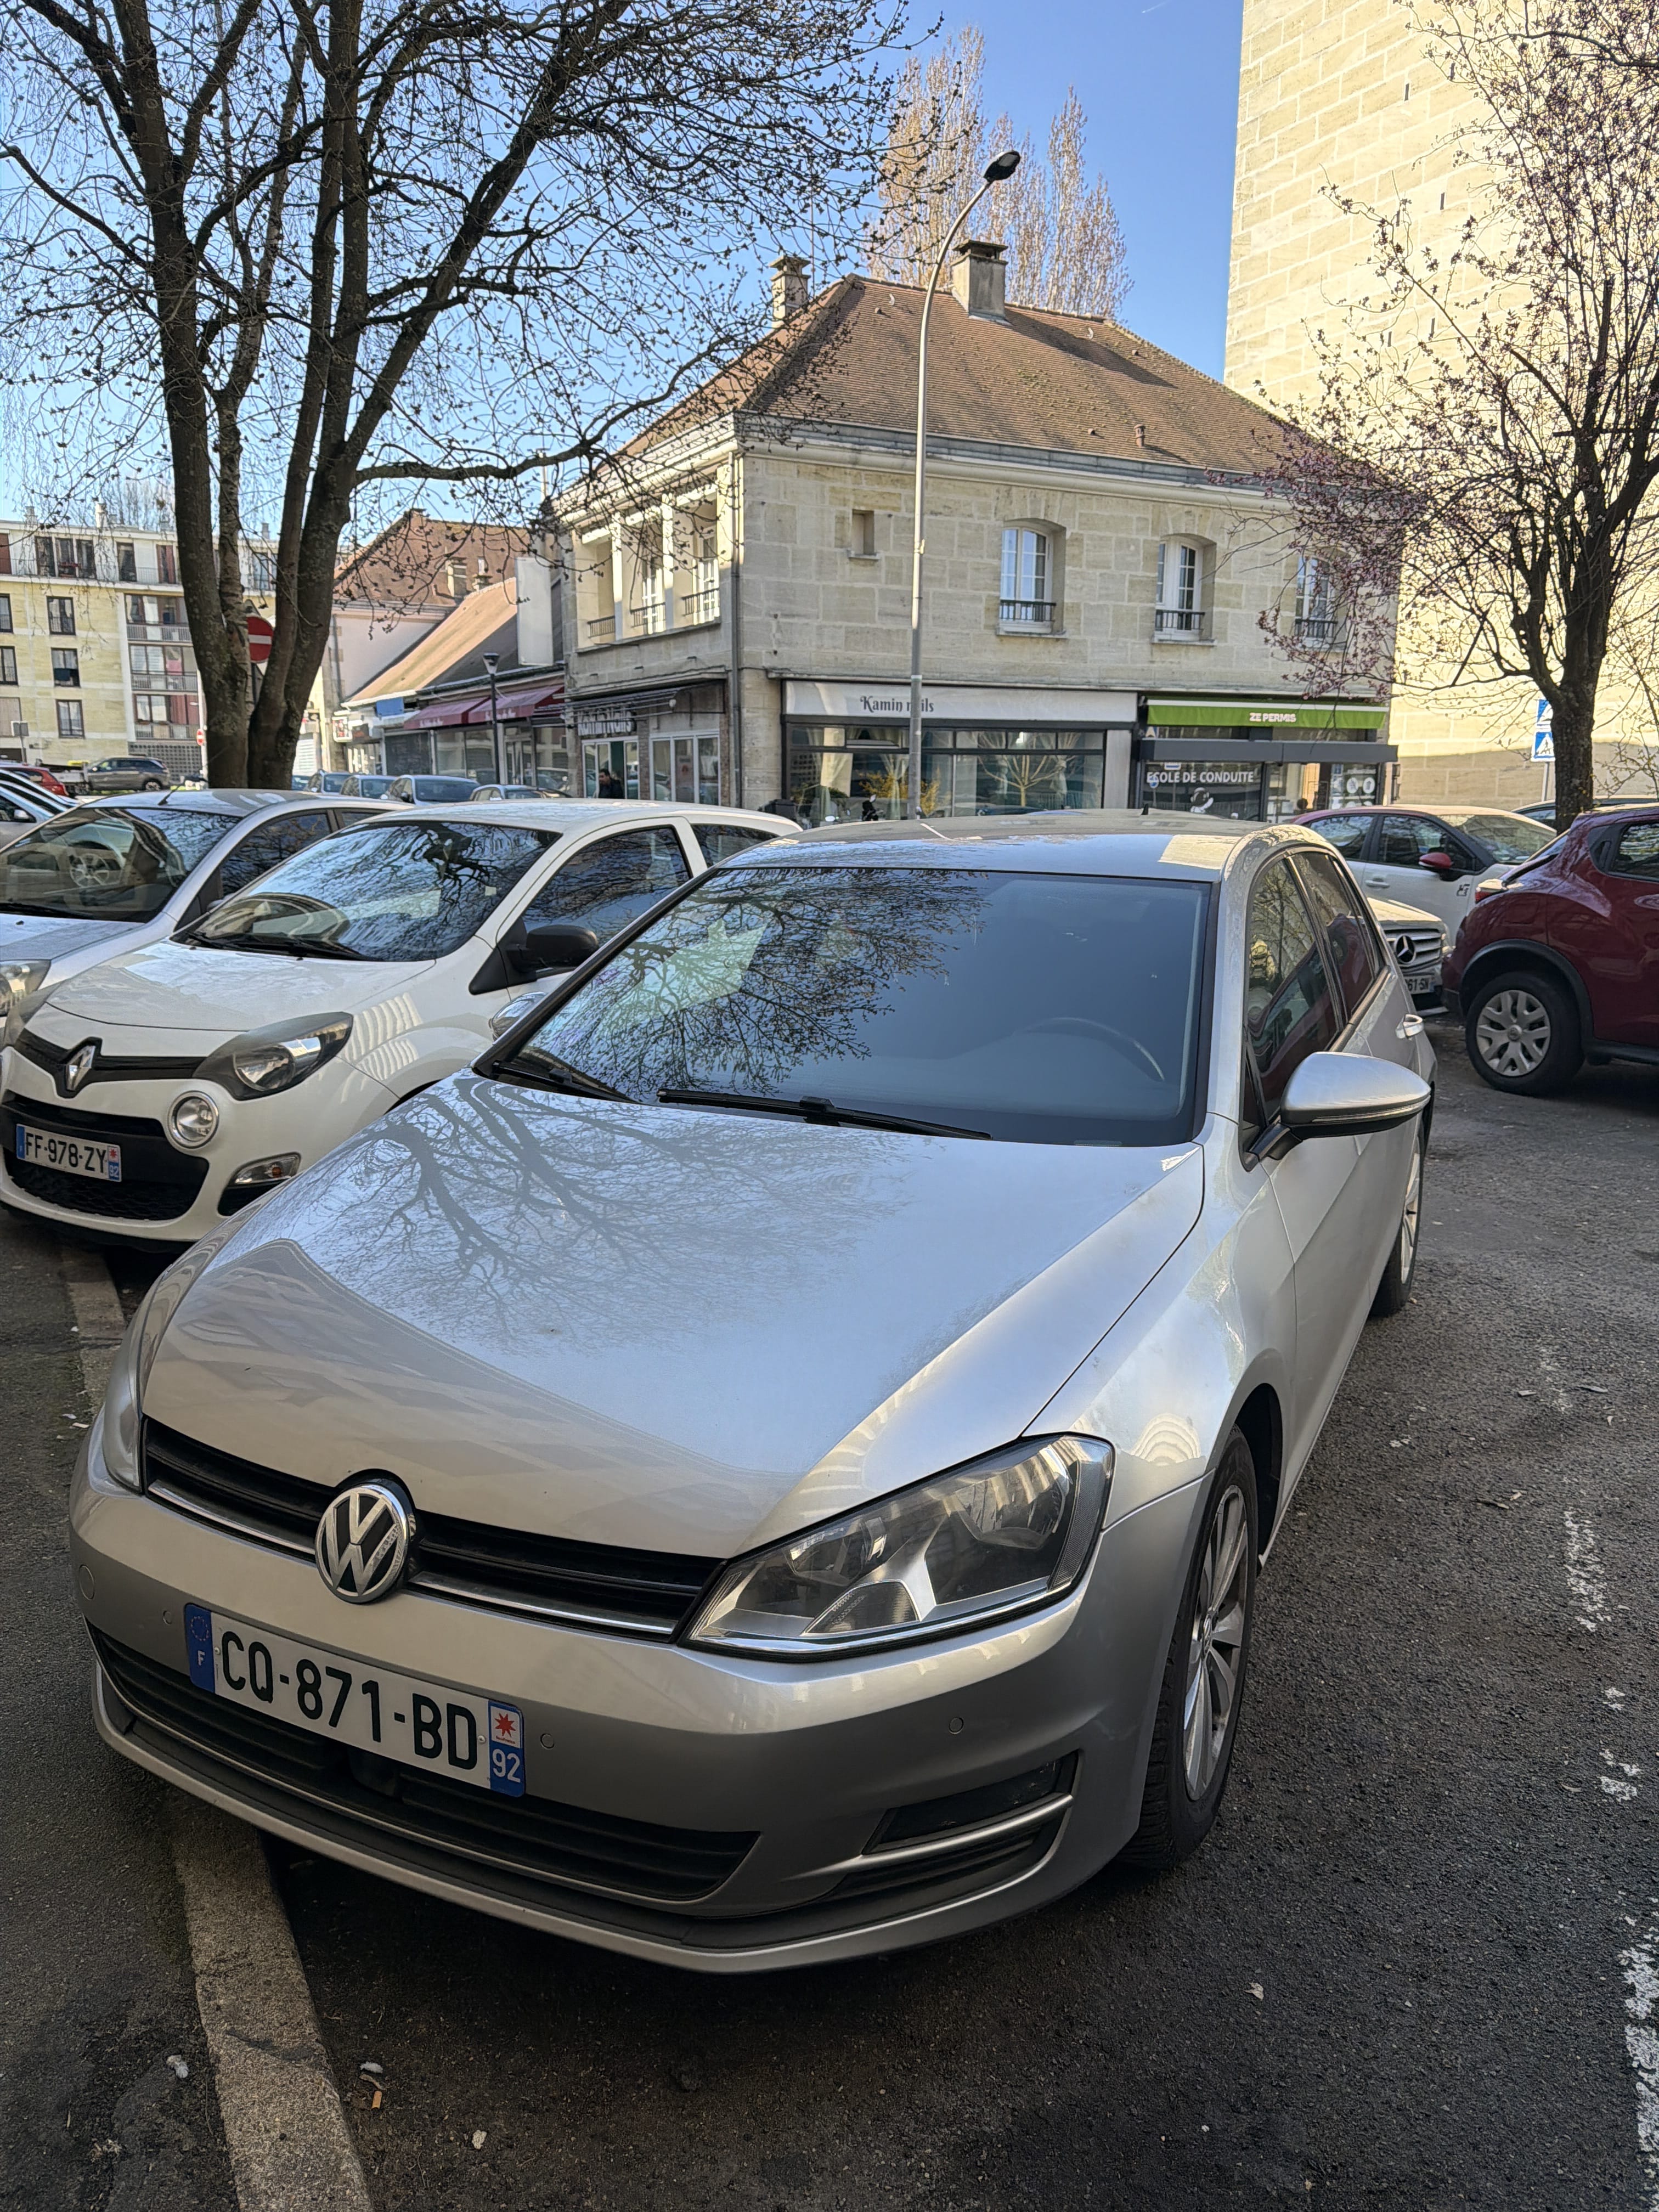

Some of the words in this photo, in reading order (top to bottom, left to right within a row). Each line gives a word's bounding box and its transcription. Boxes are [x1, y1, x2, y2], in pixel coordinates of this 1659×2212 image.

[860, 695, 903, 713] Kamin
[906, 698, 934, 713] nils
[1249, 712, 1261, 723] ZE
[1262, 713, 1297, 723] PERMIS
[1147, 771, 1180, 783] ECOLE
[1182, 771, 1197, 783] DE
[1199, 771, 1254, 783] CONDUITE
[26, 1132, 106, 1173] FF-978-ZY
[198, 1650, 206, 1666] F
[221, 1631, 477, 1770] CQ-871-BD
[492, 1748, 521, 1783] 92
